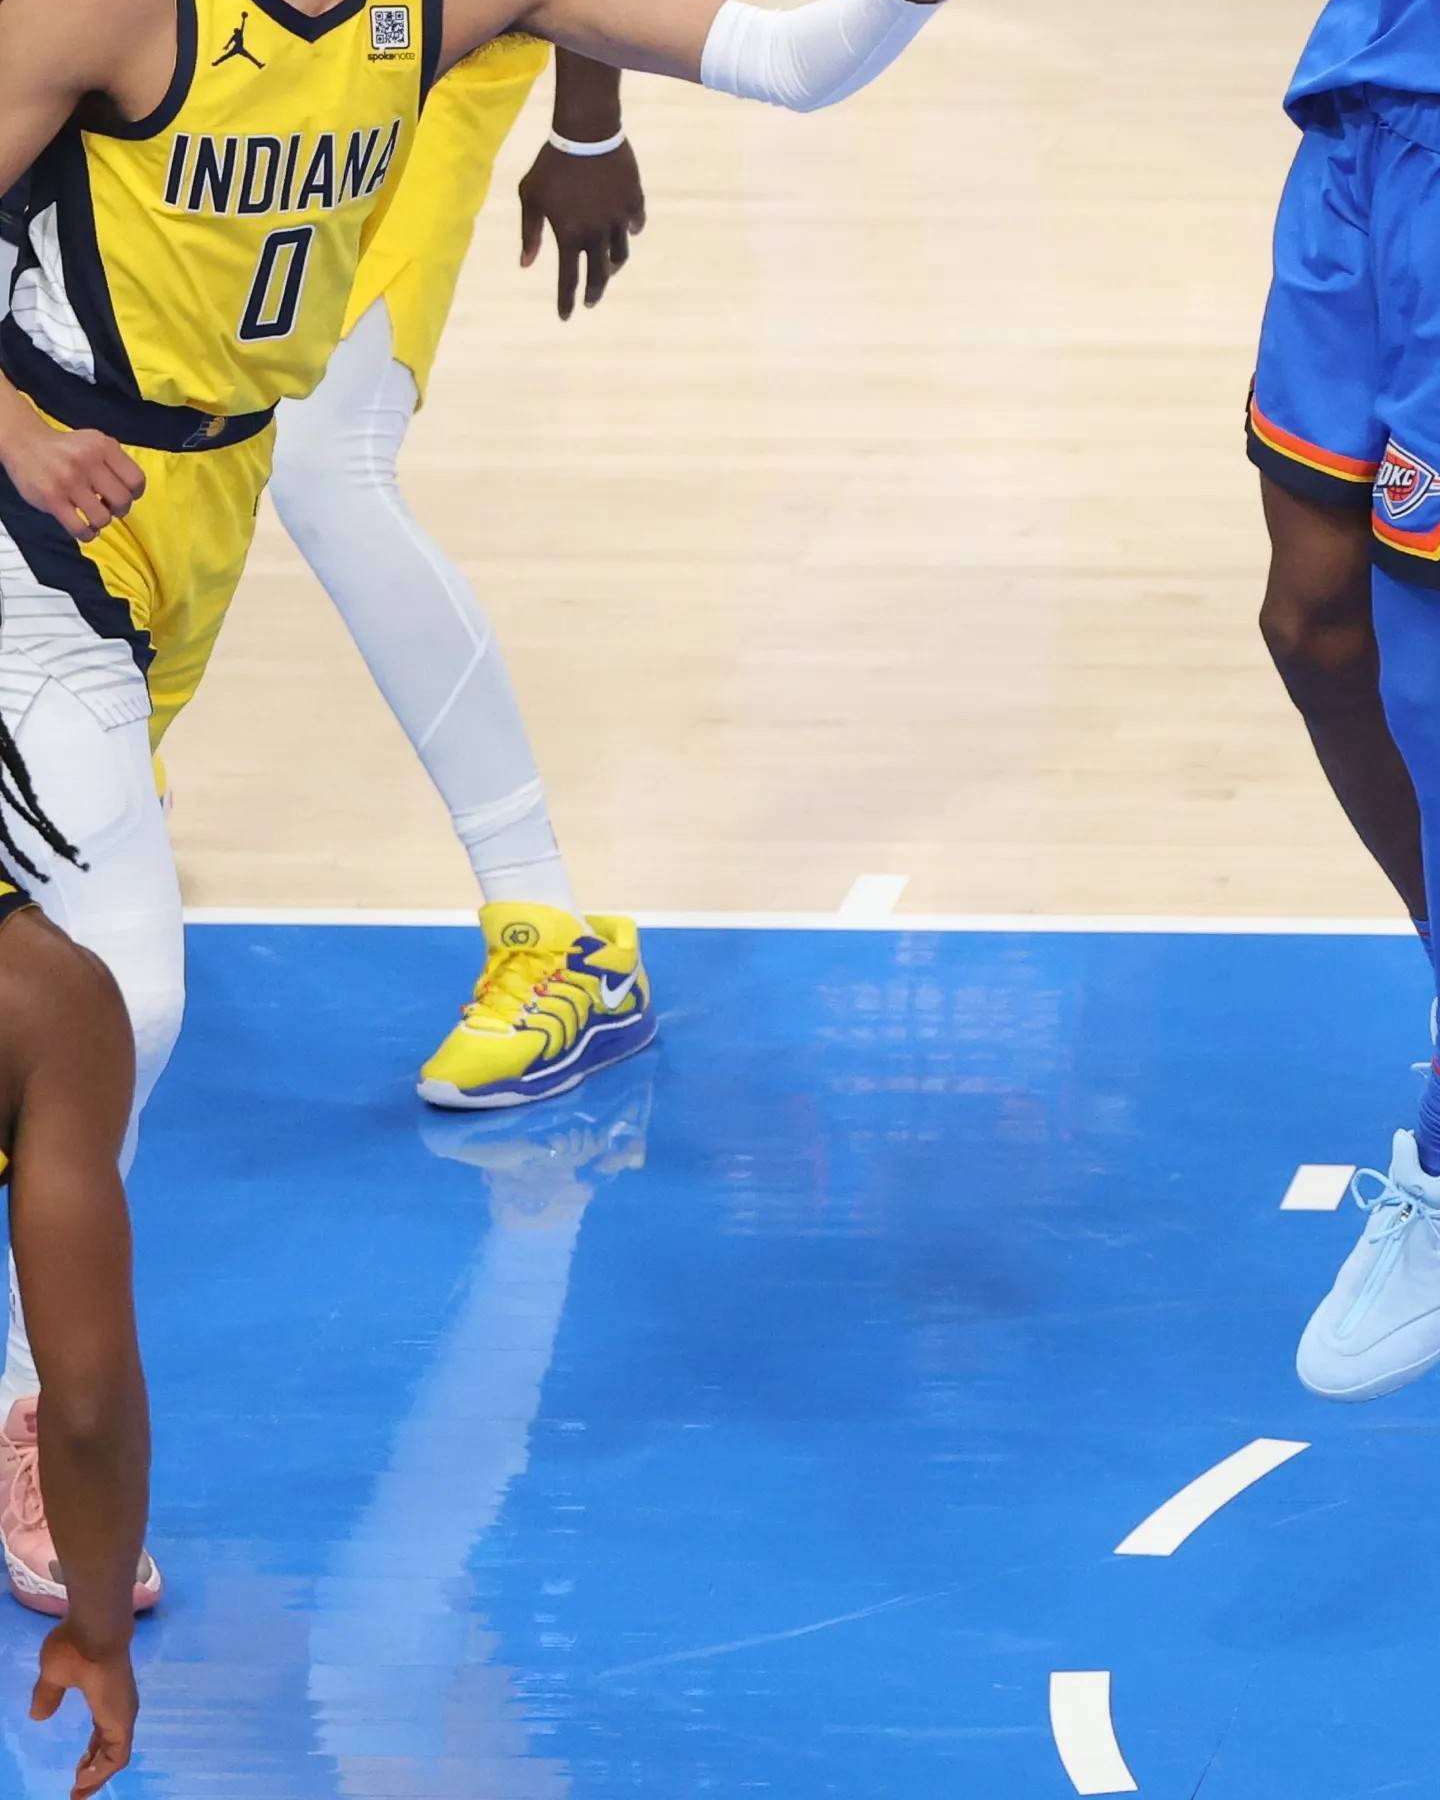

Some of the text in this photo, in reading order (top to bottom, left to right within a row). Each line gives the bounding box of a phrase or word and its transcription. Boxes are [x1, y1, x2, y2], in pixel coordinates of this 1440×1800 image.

[367, 51, 416, 64] spokenote
[162, 116, 403, 217] INDIANA
[237, 224, 315, 342] 0
